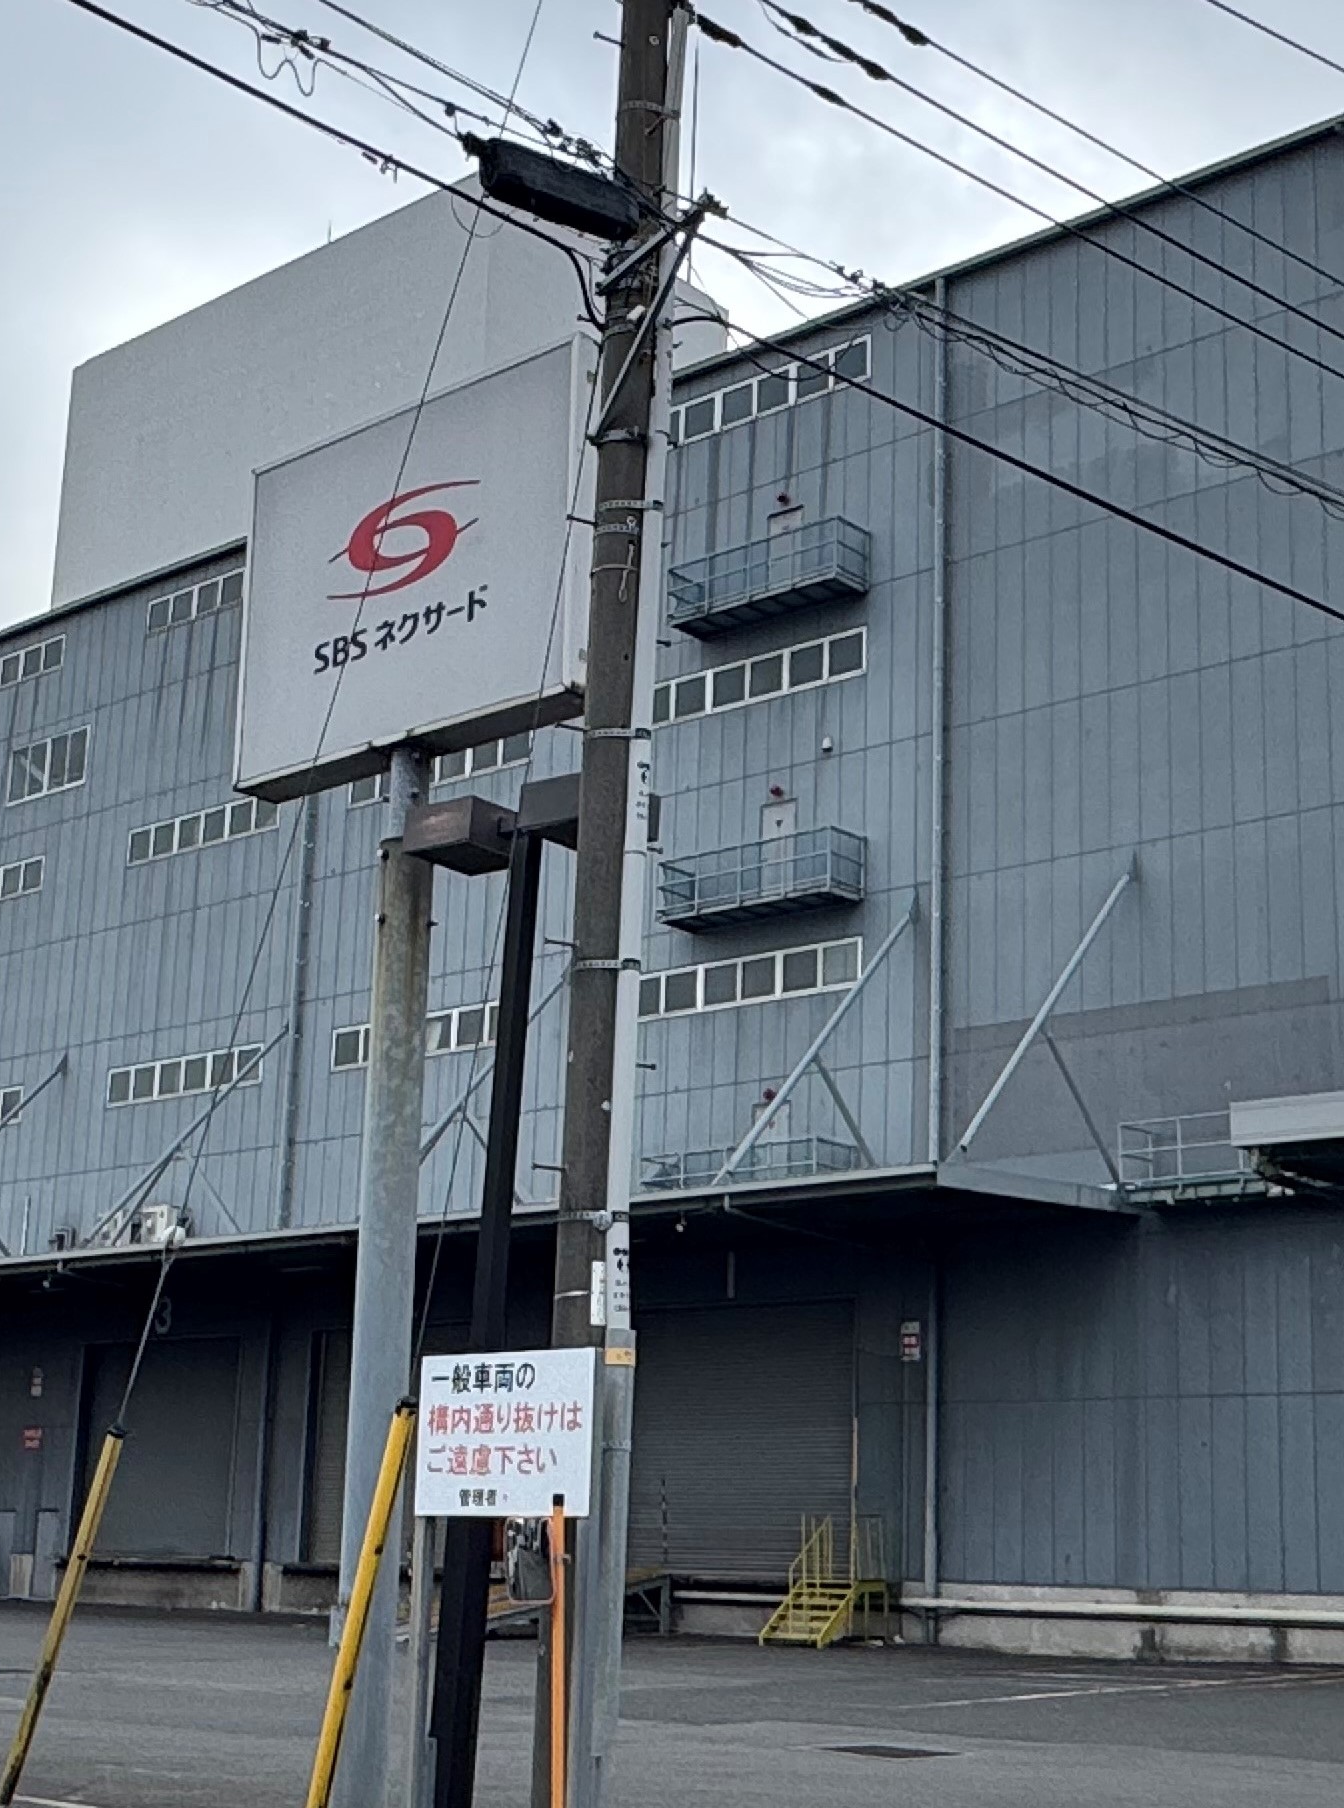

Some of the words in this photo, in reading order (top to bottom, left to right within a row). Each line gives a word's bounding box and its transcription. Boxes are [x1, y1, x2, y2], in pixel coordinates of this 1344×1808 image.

[313, 628, 368, 674] SBS
[374, 584, 488, 651] ネクサード
[431, 1361, 536, 1394] 一般車両の
[427, 1400, 583, 1436] 構内通り抜けは
[427, 1443, 557, 1476] ご遠慮下さい
